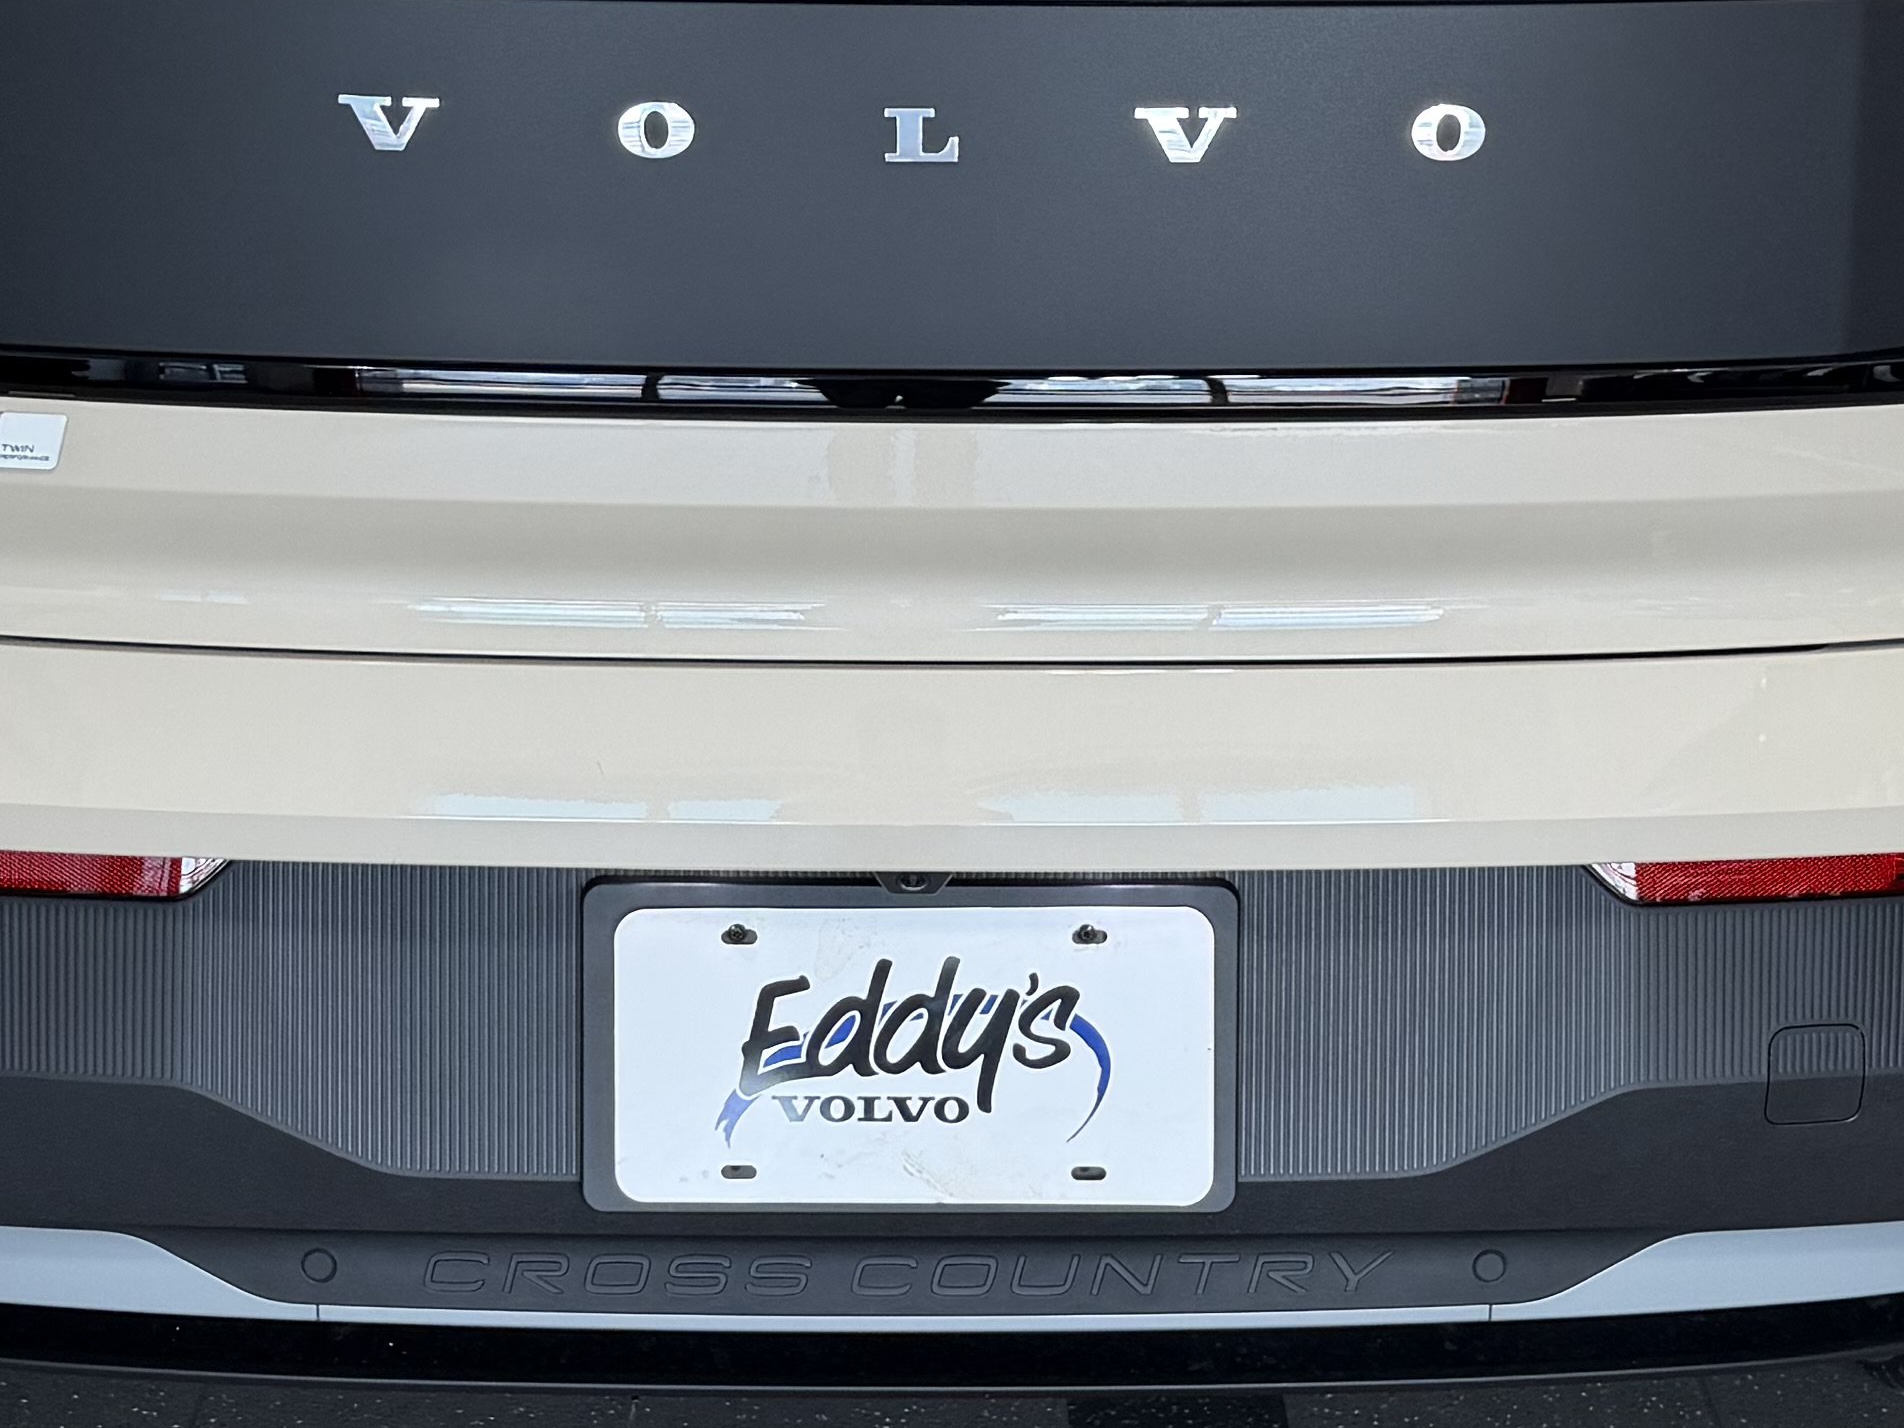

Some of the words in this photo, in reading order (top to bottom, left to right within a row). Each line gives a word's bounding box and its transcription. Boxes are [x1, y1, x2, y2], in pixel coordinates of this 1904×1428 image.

[337, 92, 1488, 164] VOLVO
[1, 443, 35, 454] TWIN
[738, 956, 1081, 1114] Eddy's
[772, 1094, 971, 1125] VOLVO
[423, 1250, 814, 1296] CROSS
[851, 1250, 1394, 1298] COUNTRY
